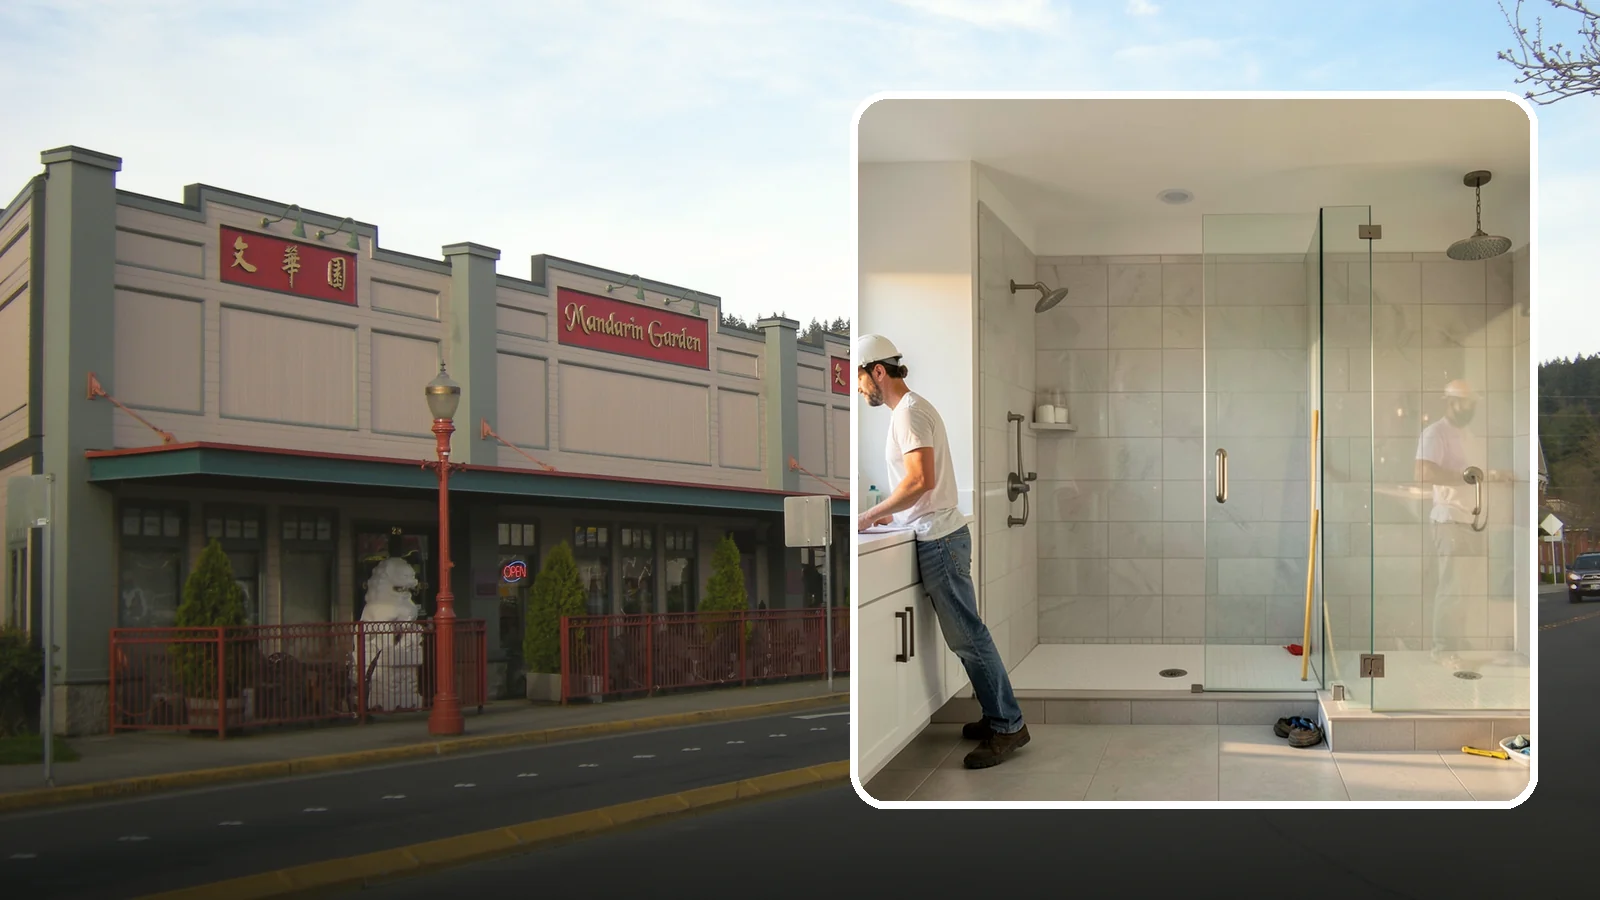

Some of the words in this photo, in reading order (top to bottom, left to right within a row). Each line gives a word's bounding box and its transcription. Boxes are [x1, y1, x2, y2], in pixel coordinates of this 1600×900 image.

[231, 235, 346, 291] 文華園
[564, 302, 644, 341] Mandarin
[647, 320, 702, 352] Garden
[503, 565, 527, 578] OPEN
